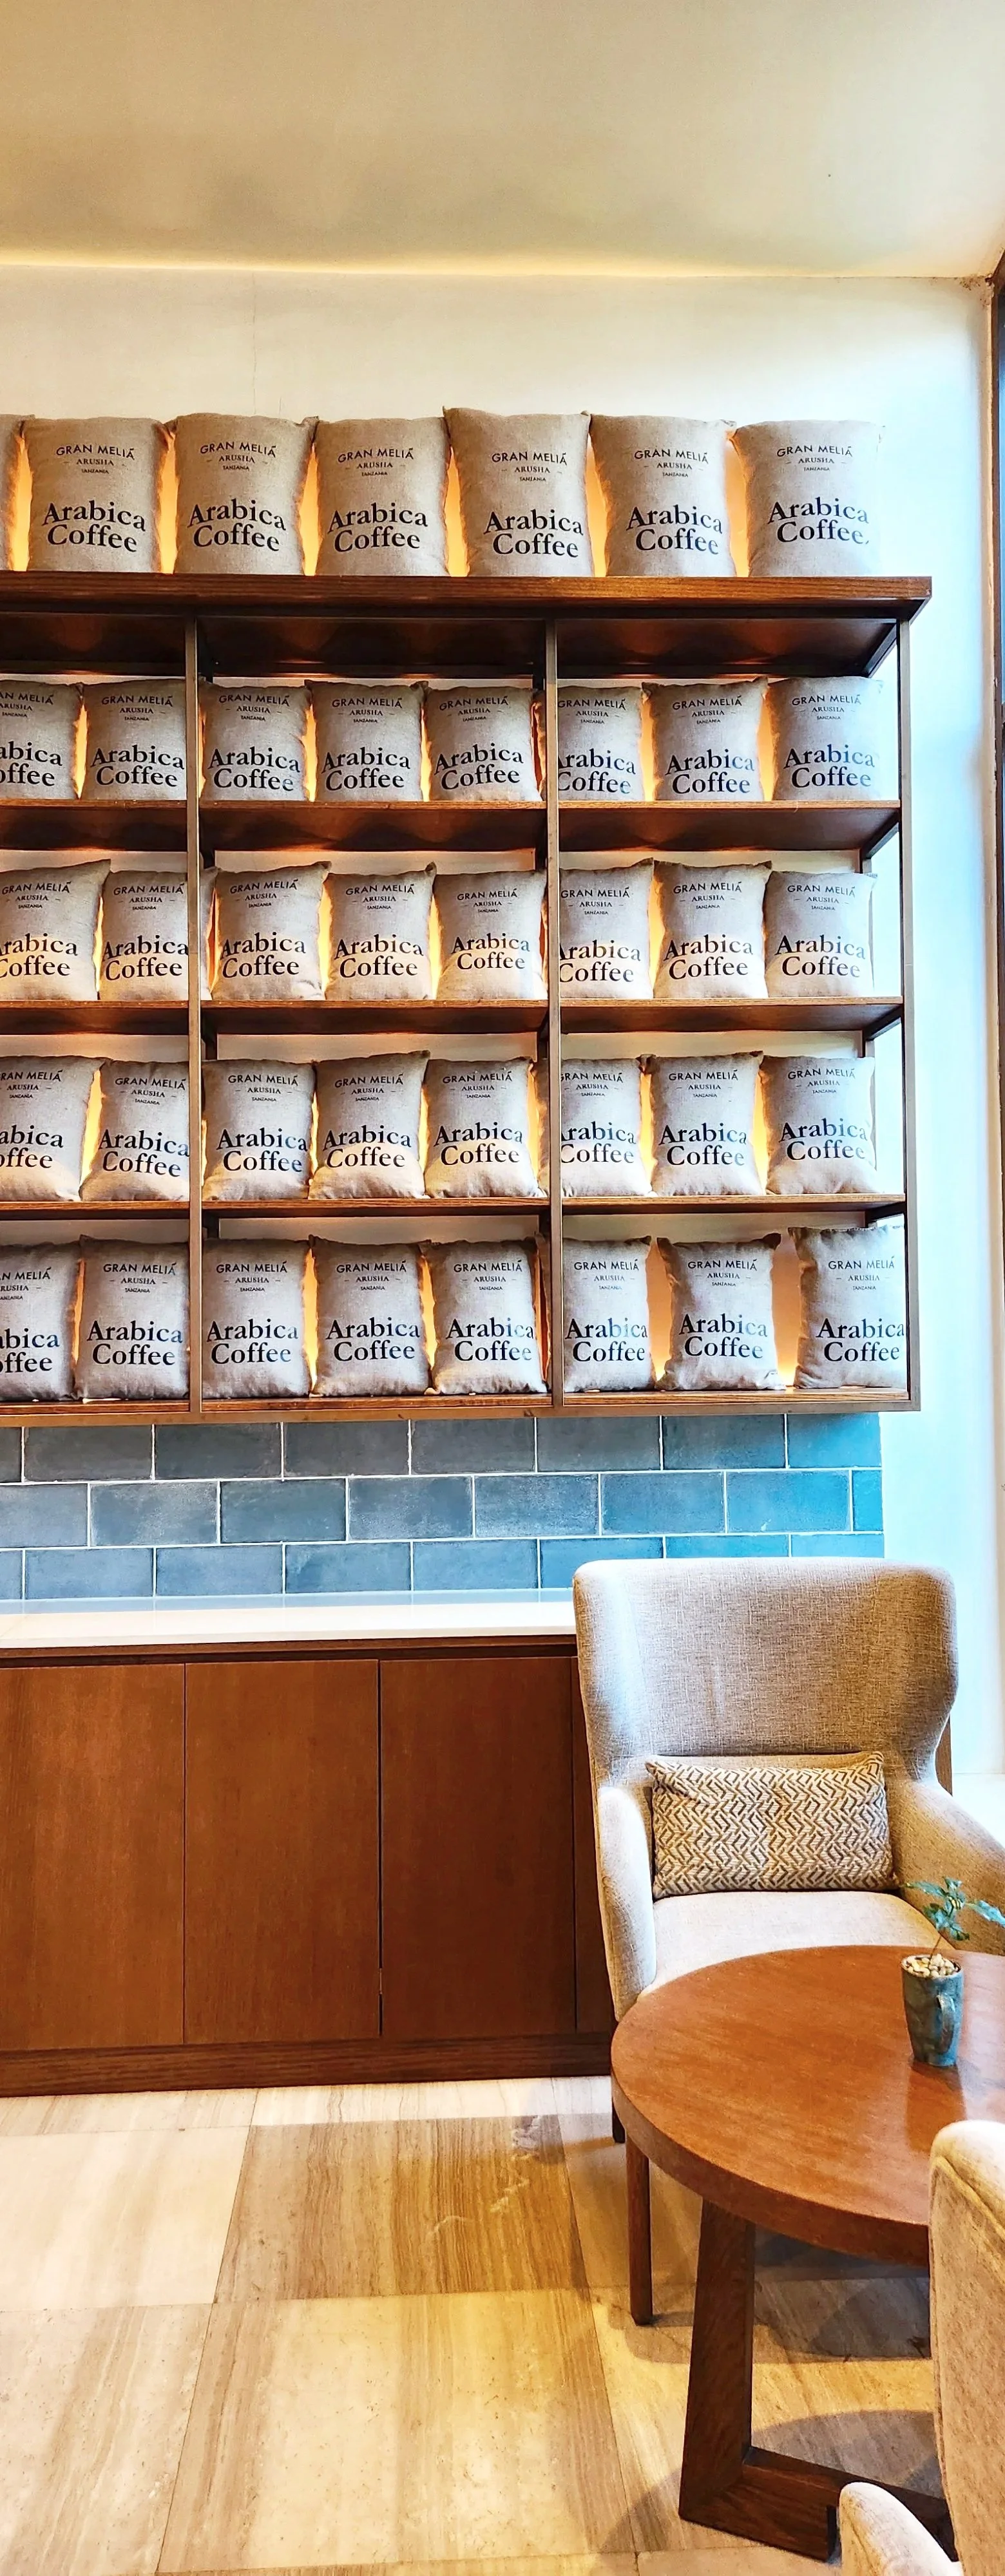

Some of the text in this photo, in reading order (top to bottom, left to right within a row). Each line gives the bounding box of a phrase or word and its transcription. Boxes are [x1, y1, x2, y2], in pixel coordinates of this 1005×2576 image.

[56, 444, 95, 455] GRAN
[200, 441, 235, 454] GRAN
[492, 451, 528, 462] GRAN
[635, 448, 671, 459] GRAN
[777, 445, 812, 457] GRAN
[42, 500, 146, 531] Arabica
[187, 498, 286, 531] Arabica
[327, 502, 428, 533] Arabica
[626, 504, 722, 533] Arabica
[767, 497, 868, 524] Arabica
[484, 509, 583, 536] Arabica
[48, 524, 139, 552] Coffee
[194, 522, 280, 551] Coffee
[335, 526, 420, 552] Coffee
[493, 531, 579, 558] Coffee
[636, 529, 719, 554] Coffee
[102, 696, 134, 706] GRAN
[219, 694, 251, 705] GRAN
[332, 698, 365, 707] GRAN
[673, 699, 705, 711] GRAN
[792, 695, 825, 706] GRAN
[92, 744, 184, 769] Arabica
[208, 746, 300, 773] Arabica
[321, 747, 410, 773] Arabica
[434, 743, 524, 775] Arabica
[665, 749, 754, 776] Arabica
[783, 744, 874, 769] Arabica
[97, 765, 178, 787] Coffee
[214, 768, 294, 791] Coffee
[326, 768, 404, 790] Coffee
[441, 764, 520, 790] Coffee
[673, 772, 749, 793] Coffee
[792, 766, 870, 788] Coffee
[2, 884, 32, 895] GRAN
[113, 886, 145, 895] GRAN
[346, 885, 378, 895] GRAN
[457, 892, 487, 900] GRAN
[559, 887, 593, 899] GRAN
[673, 883, 709, 894] GRAN
[787, 884, 821, 893] GRAN
[104, 935, 188, 961] Arabica
[220, 932, 306, 960] Arabica
[332, 934, 423, 960] Arabica
[450, 933, 530, 954] Arabica
[663, 934, 752, 961] Arabica
[774, 934, 866, 960] Arabica
[105, 956, 182, 980] Coffee
[222, 954, 299, 978] Coffee
[340, 955, 417, 978] Coffee
[457, 952, 524, 969] Coffee
[669, 956, 747, 980] Coffee
[781, 956, 861, 978] Coffee
[115, 1077, 148, 1086] GRAN
[228, 1074, 262, 1083] GRAN
[335, 1077, 365, 1088] GRAN
[443, 1074, 476, 1085] GRAN
[669, 1072, 701, 1081] GRAN
[788, 1066, 821, 1079] GRAN
[216, 1128, 307, 1152] Arabica
[323, 1125, 412, 1150] Arabica
[434, 1122, 522, 1147] Arabica
[658, 1122, 746, 1146] Arabica
[778, 1118, 866, 1143] Arabica
[99, 1129, 189, 1157] Arabica
[441, 1143, 519, 1165] Coffee
[787, 1139, 864, 1160] Coffee
[103, 1151, 181, 1177] Coffee
[224, 1150, 302, 1172] Coffee
[327, 1146, 405, 1168] Coffee
[667, 1144, 743, 1165] Coffee
[103, 1264, 137, 1273] GRAN
[216, 1264, 249, 1273] GRAN
[336, 1264, 369, 1273] GRAN
[454, 1263, 487, 1273] GRAN
[574, 1262, 606, 1270] GRAN
[688, 1260, 720, 1269] GRAN
[828, 1260, 861, 1269] GRAN
[87, 1320, 183, 1343] Arabica
[207, 1318, 298, 1342] Arabica
[325, 1317, 420, 1340] Arabica
[446, 1317, 533, 1340] Arabica
[563, 1317, 647, 1340] Arabica
[679, 1313, 767, 1337] Arabica
[816, 1318, 904, 1338] Arabica
[93, 1343, 175, 1365] Coffee
[211, 1342, 291, 1364] Coffee
[334, 1340, 415, 1361] Coffee
[455, 1340, 531, 1361] Coffee
[573, 1341, 644, 1361] Coffee
[685, 1336, 762, 1358] Coffee
[824, 1341, 899, 1361] Coffee
